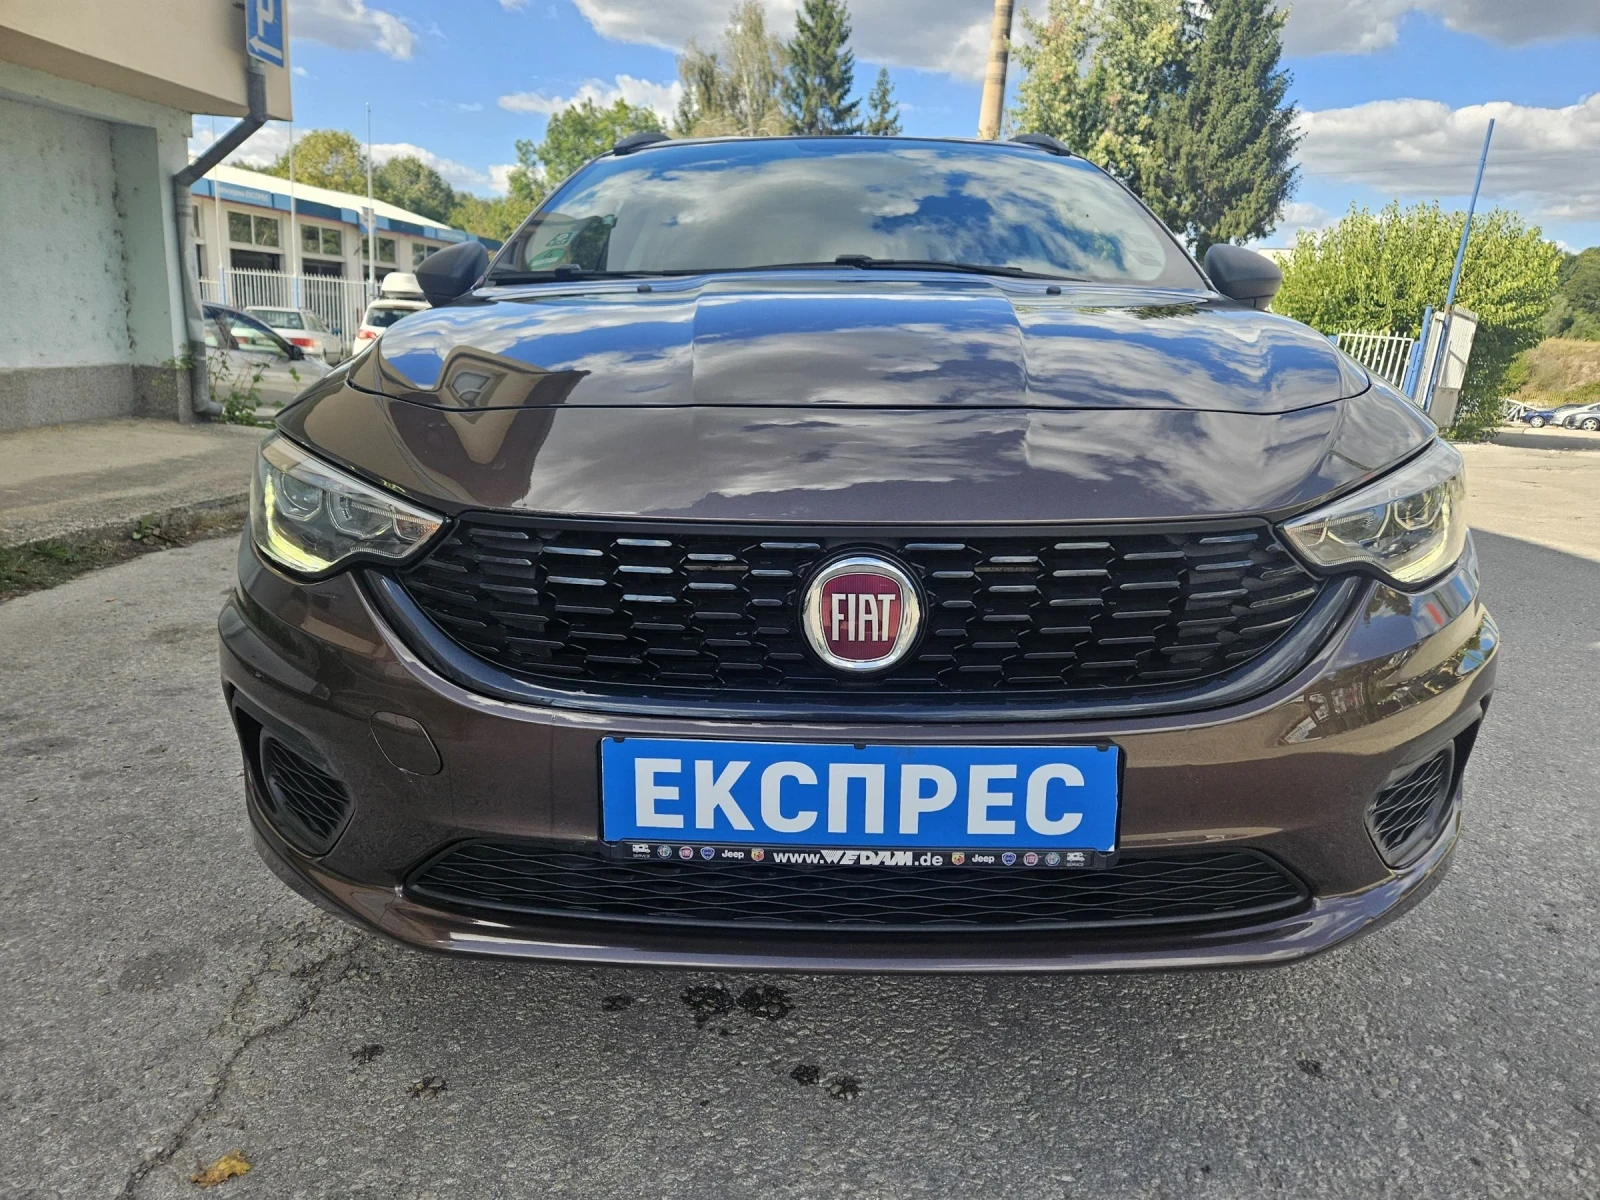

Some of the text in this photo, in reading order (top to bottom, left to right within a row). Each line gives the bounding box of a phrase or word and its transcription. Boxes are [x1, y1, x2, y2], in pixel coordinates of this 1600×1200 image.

[256, 0, 274, 37] P
[831, 593, 896, 642] FIAT
[634, 757, 1085, 836] ЕКСПРЕС
[721, 849, 745, 859] Jeep
[972, 854, 995, 865] Jeep
